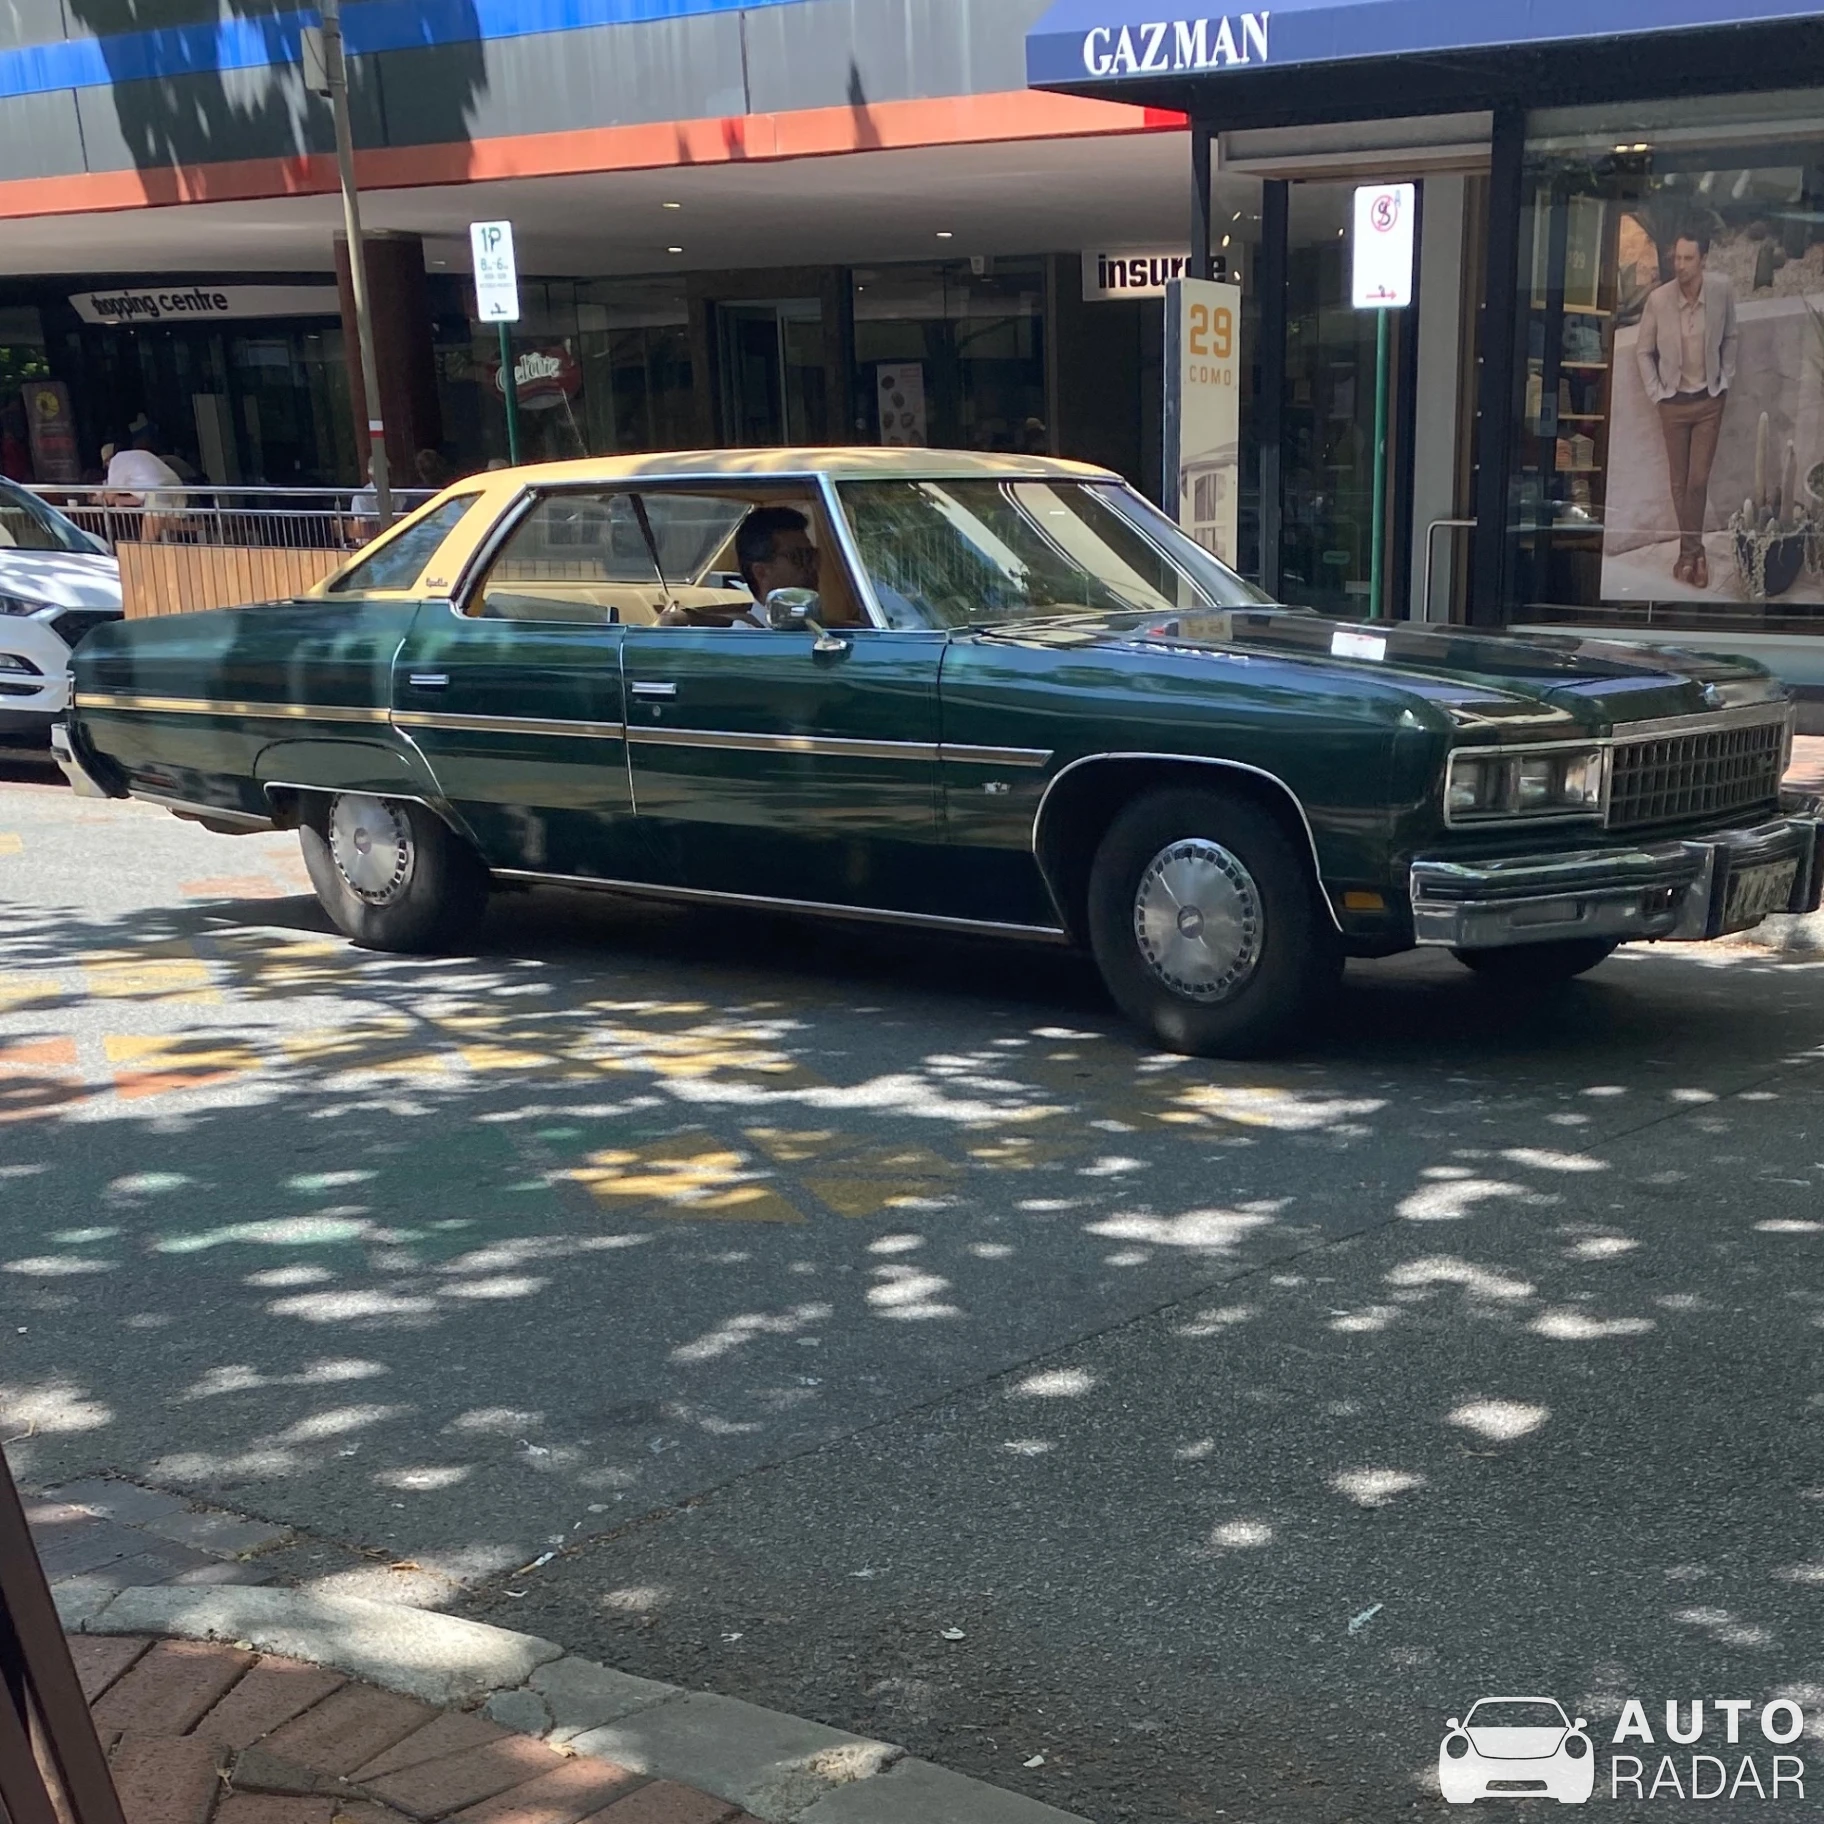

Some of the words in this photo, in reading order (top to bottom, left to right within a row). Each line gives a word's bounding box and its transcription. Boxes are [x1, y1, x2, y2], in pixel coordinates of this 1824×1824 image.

[1083, 10, 1270, 76] GAZMAN
[481, 226, 502, 253] 1P
[1098, 253, 1227, 288] insure
[158, 287, 229, 312] centre
[1189, 303, 1233, 359] 29
[1189, 364, 1232, 386] COMO
